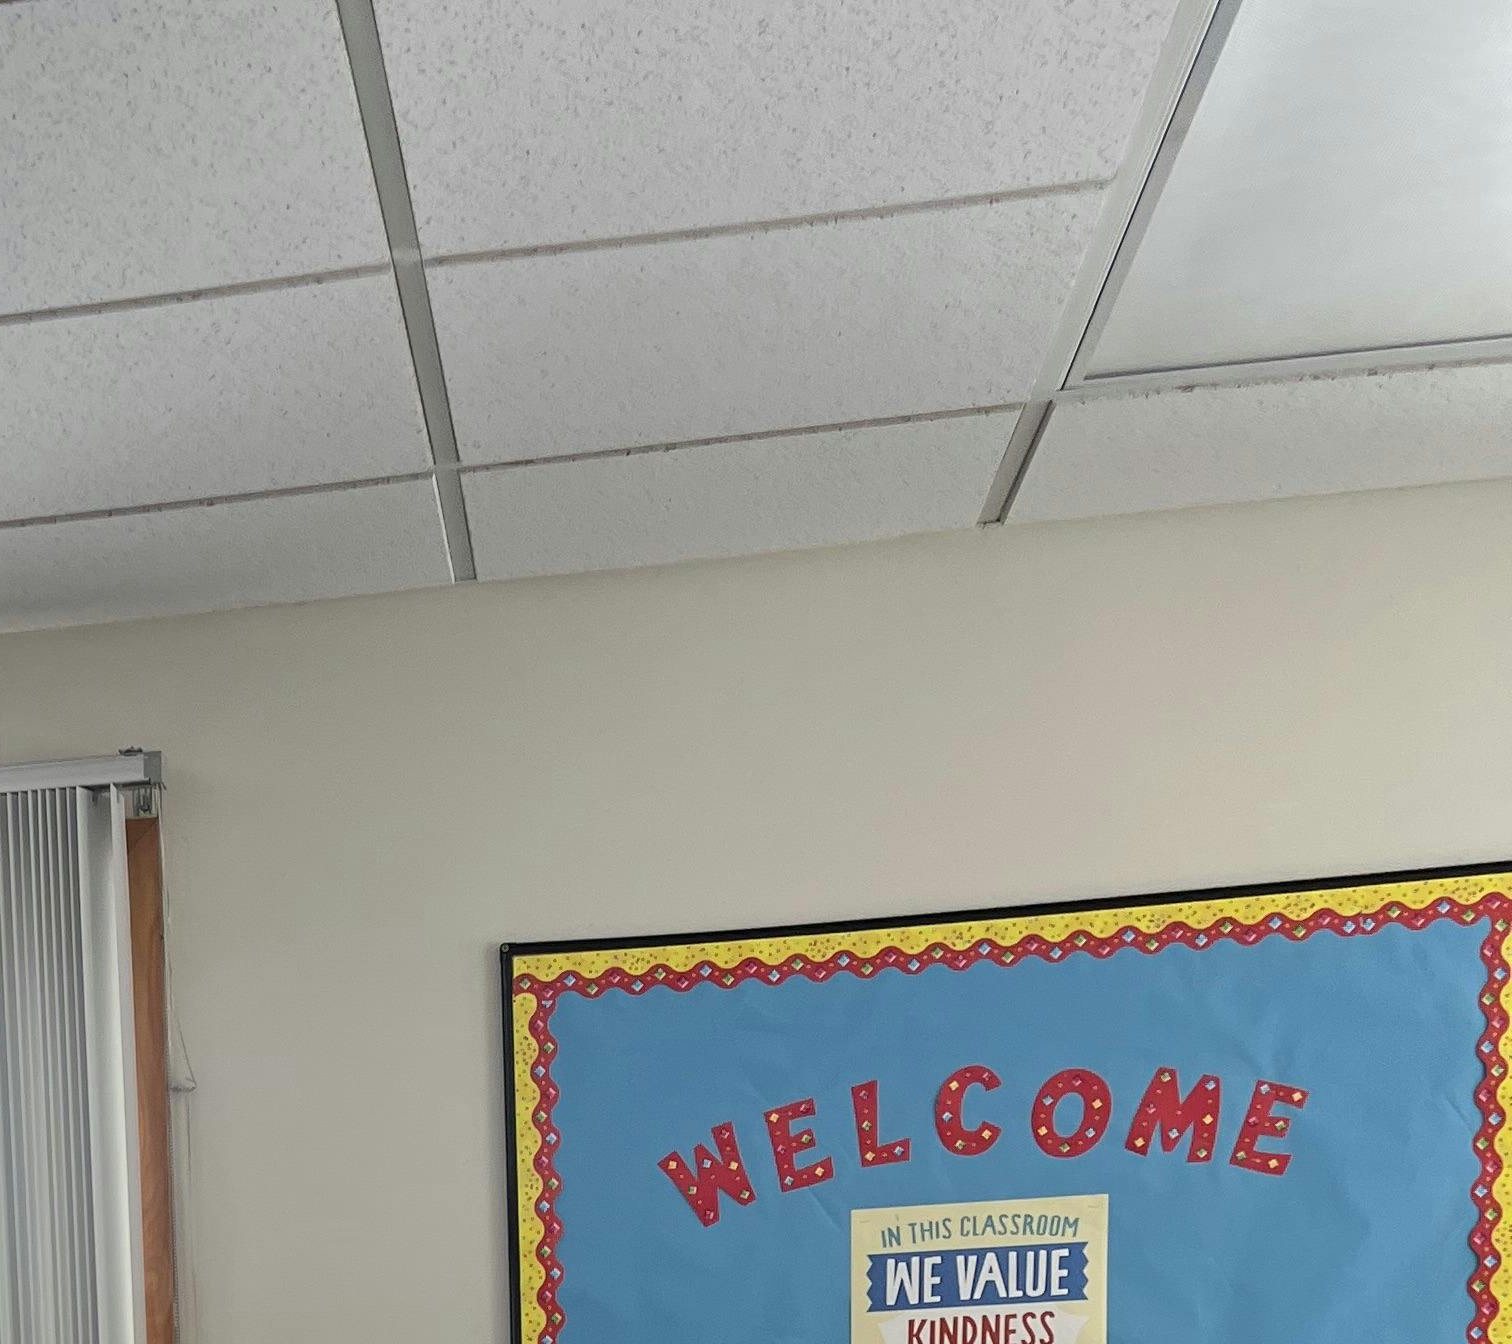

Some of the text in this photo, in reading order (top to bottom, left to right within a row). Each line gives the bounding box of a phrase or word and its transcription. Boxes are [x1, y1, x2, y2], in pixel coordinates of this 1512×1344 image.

[657, 1065, 1309, 1228] WELCOME
[881, 1214, 1080, 1248] IN THIS CLASSROOM
[885, 1248, 1070, 1306] WE VALUE
